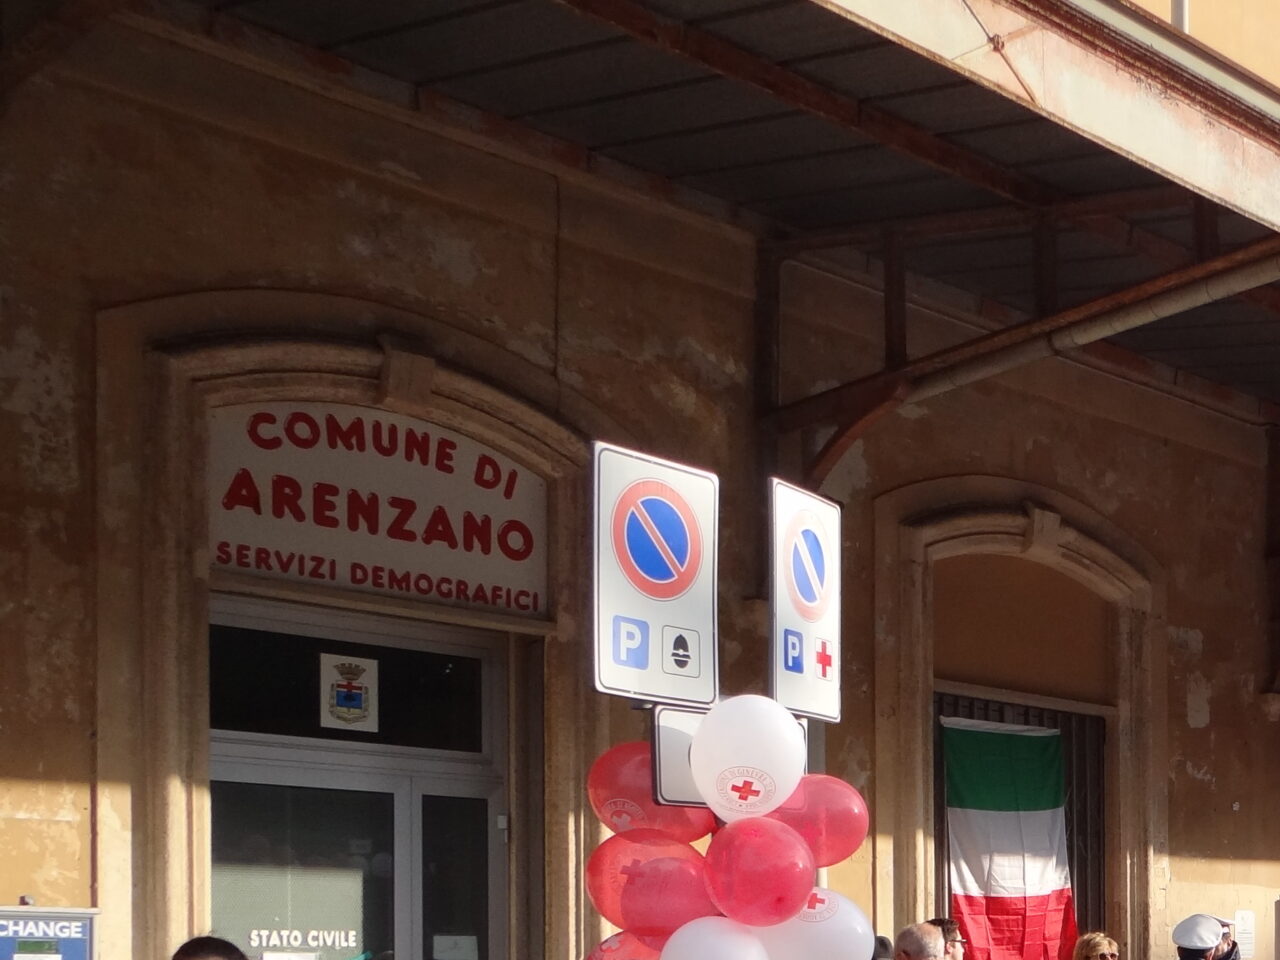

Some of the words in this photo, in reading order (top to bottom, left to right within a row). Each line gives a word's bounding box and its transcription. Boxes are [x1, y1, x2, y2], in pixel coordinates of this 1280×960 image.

[246, 411, 457, 474] COMUNE
[473, 453, 519, 500] DI
[221, 467, 535, 561] ARENZANO
[215, 541, 337, 581] SERVIZI
[350, 562, 540, 612] DEMOGRAFICI
[619, 621, 642, 661] P
[787, 635, 800, 667] P
[0, 920, 83, 937] CHANGE
[249, 929, 303, 948] STATO
[306, 929, 357, 948] CIVILE
